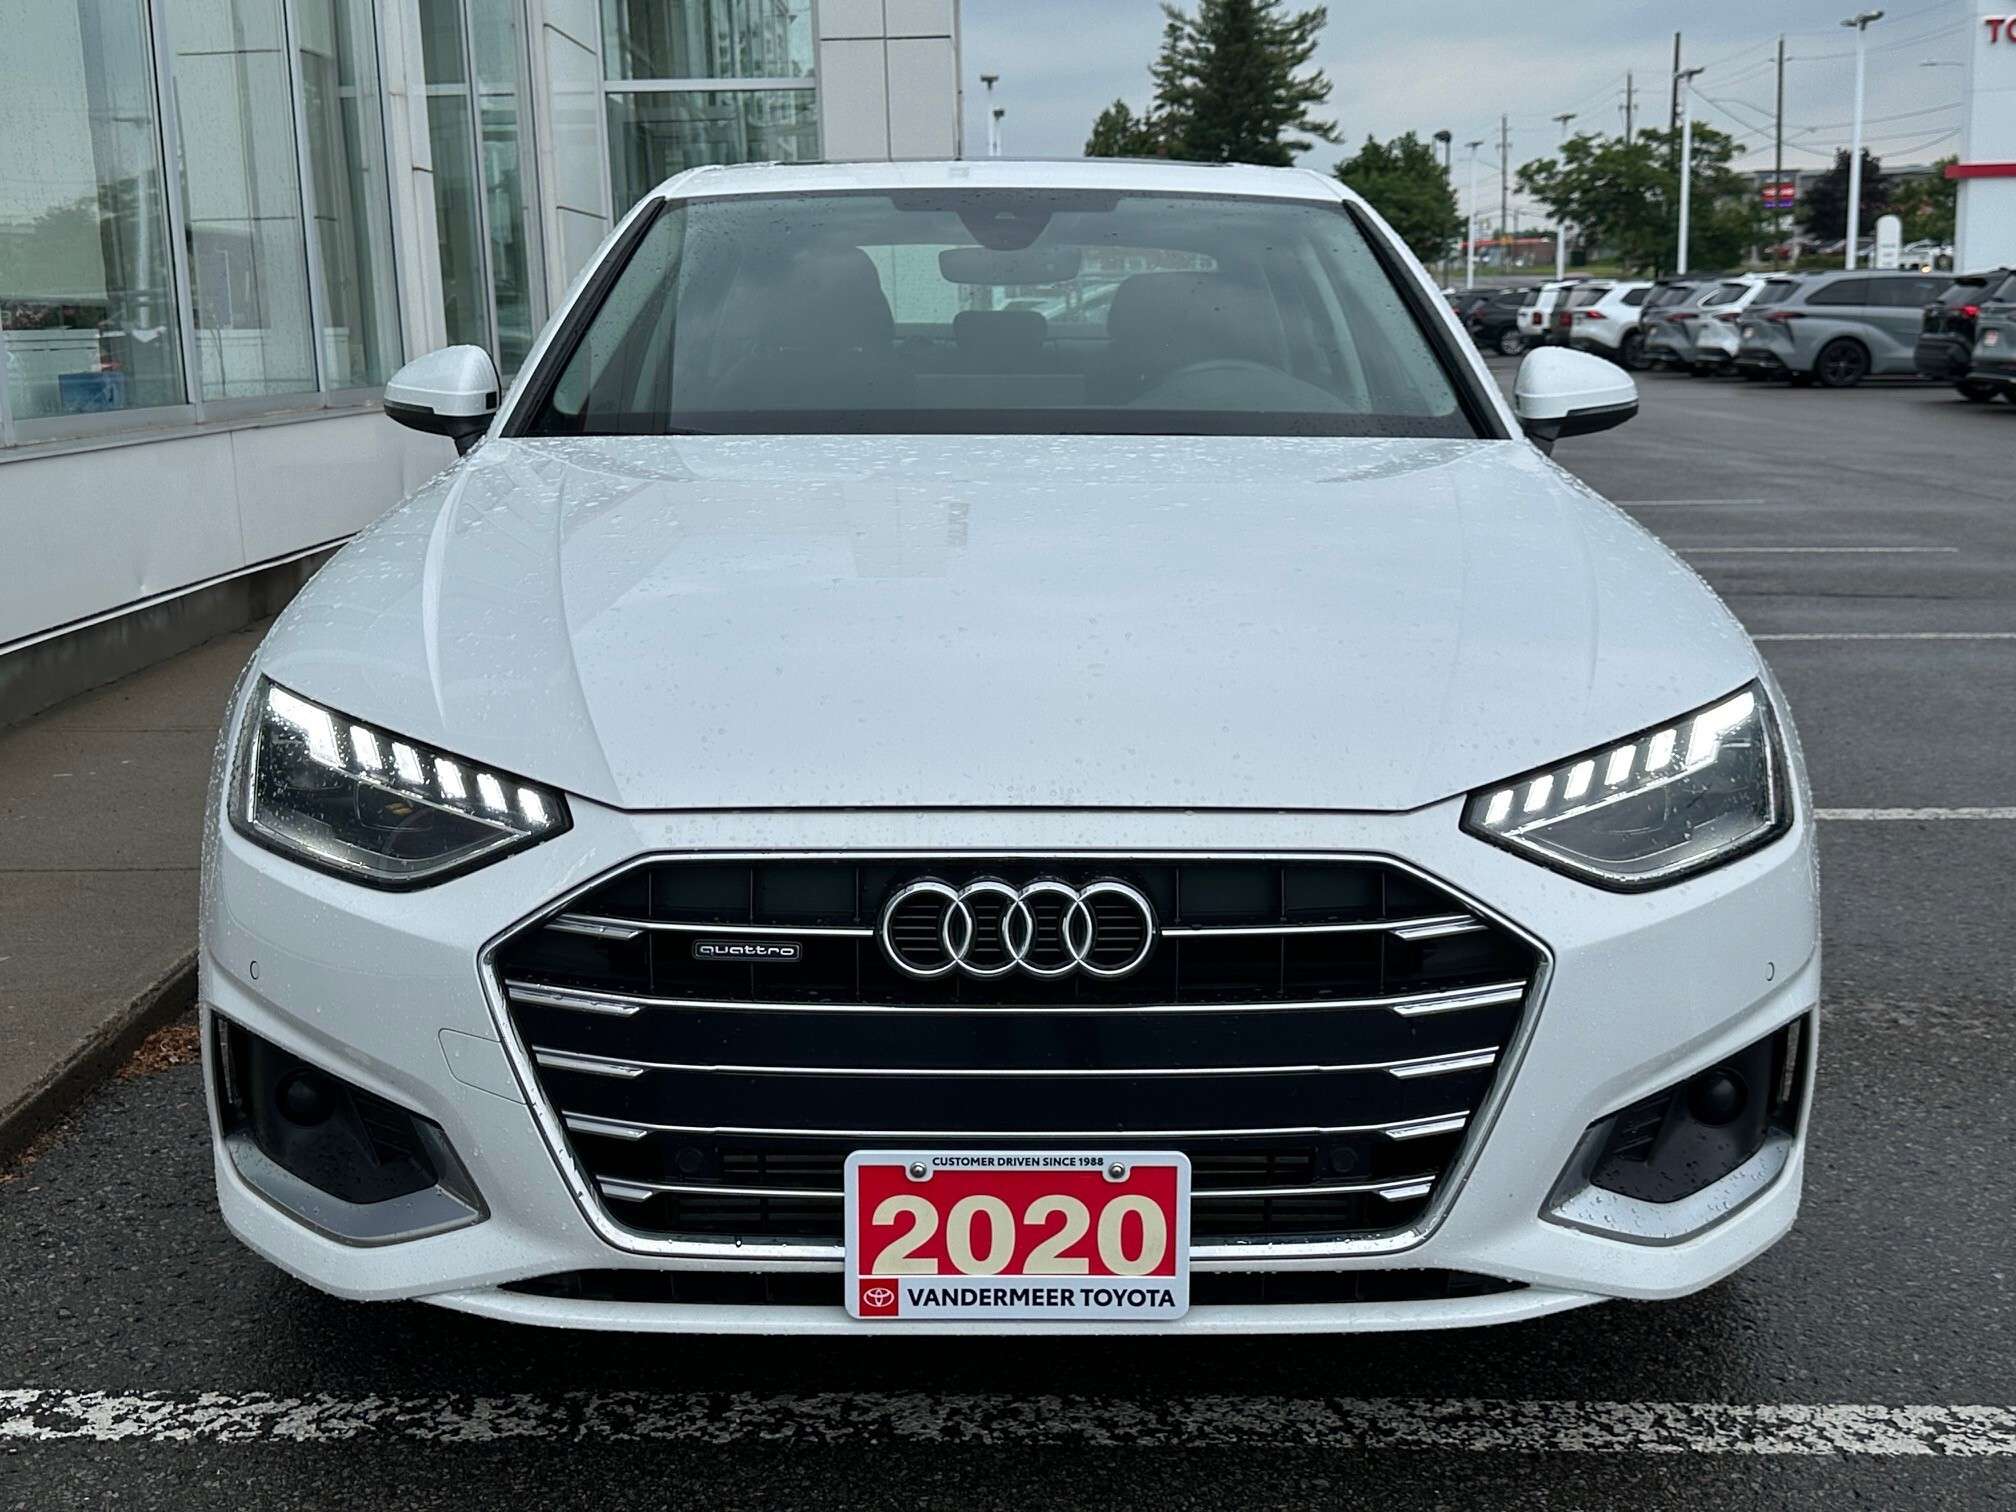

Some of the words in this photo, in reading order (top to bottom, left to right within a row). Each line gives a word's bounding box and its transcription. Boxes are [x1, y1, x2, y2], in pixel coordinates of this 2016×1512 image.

[700, 945, 795, 956] quattro
[932, 1157, 995, 1167] CUSTOMER
[997, 1157, 1040, 1167] DRIVEN
[1043, 1157, 1076, 1167] SINCE
[1078, 1157, 1104, 1167] 1988
[871, 1194, 1168, 1276] 2020
[907, 1288, 1076, 1307] VANDERMEER
[1080, 1288, 1176, 1307] TOYOTA
